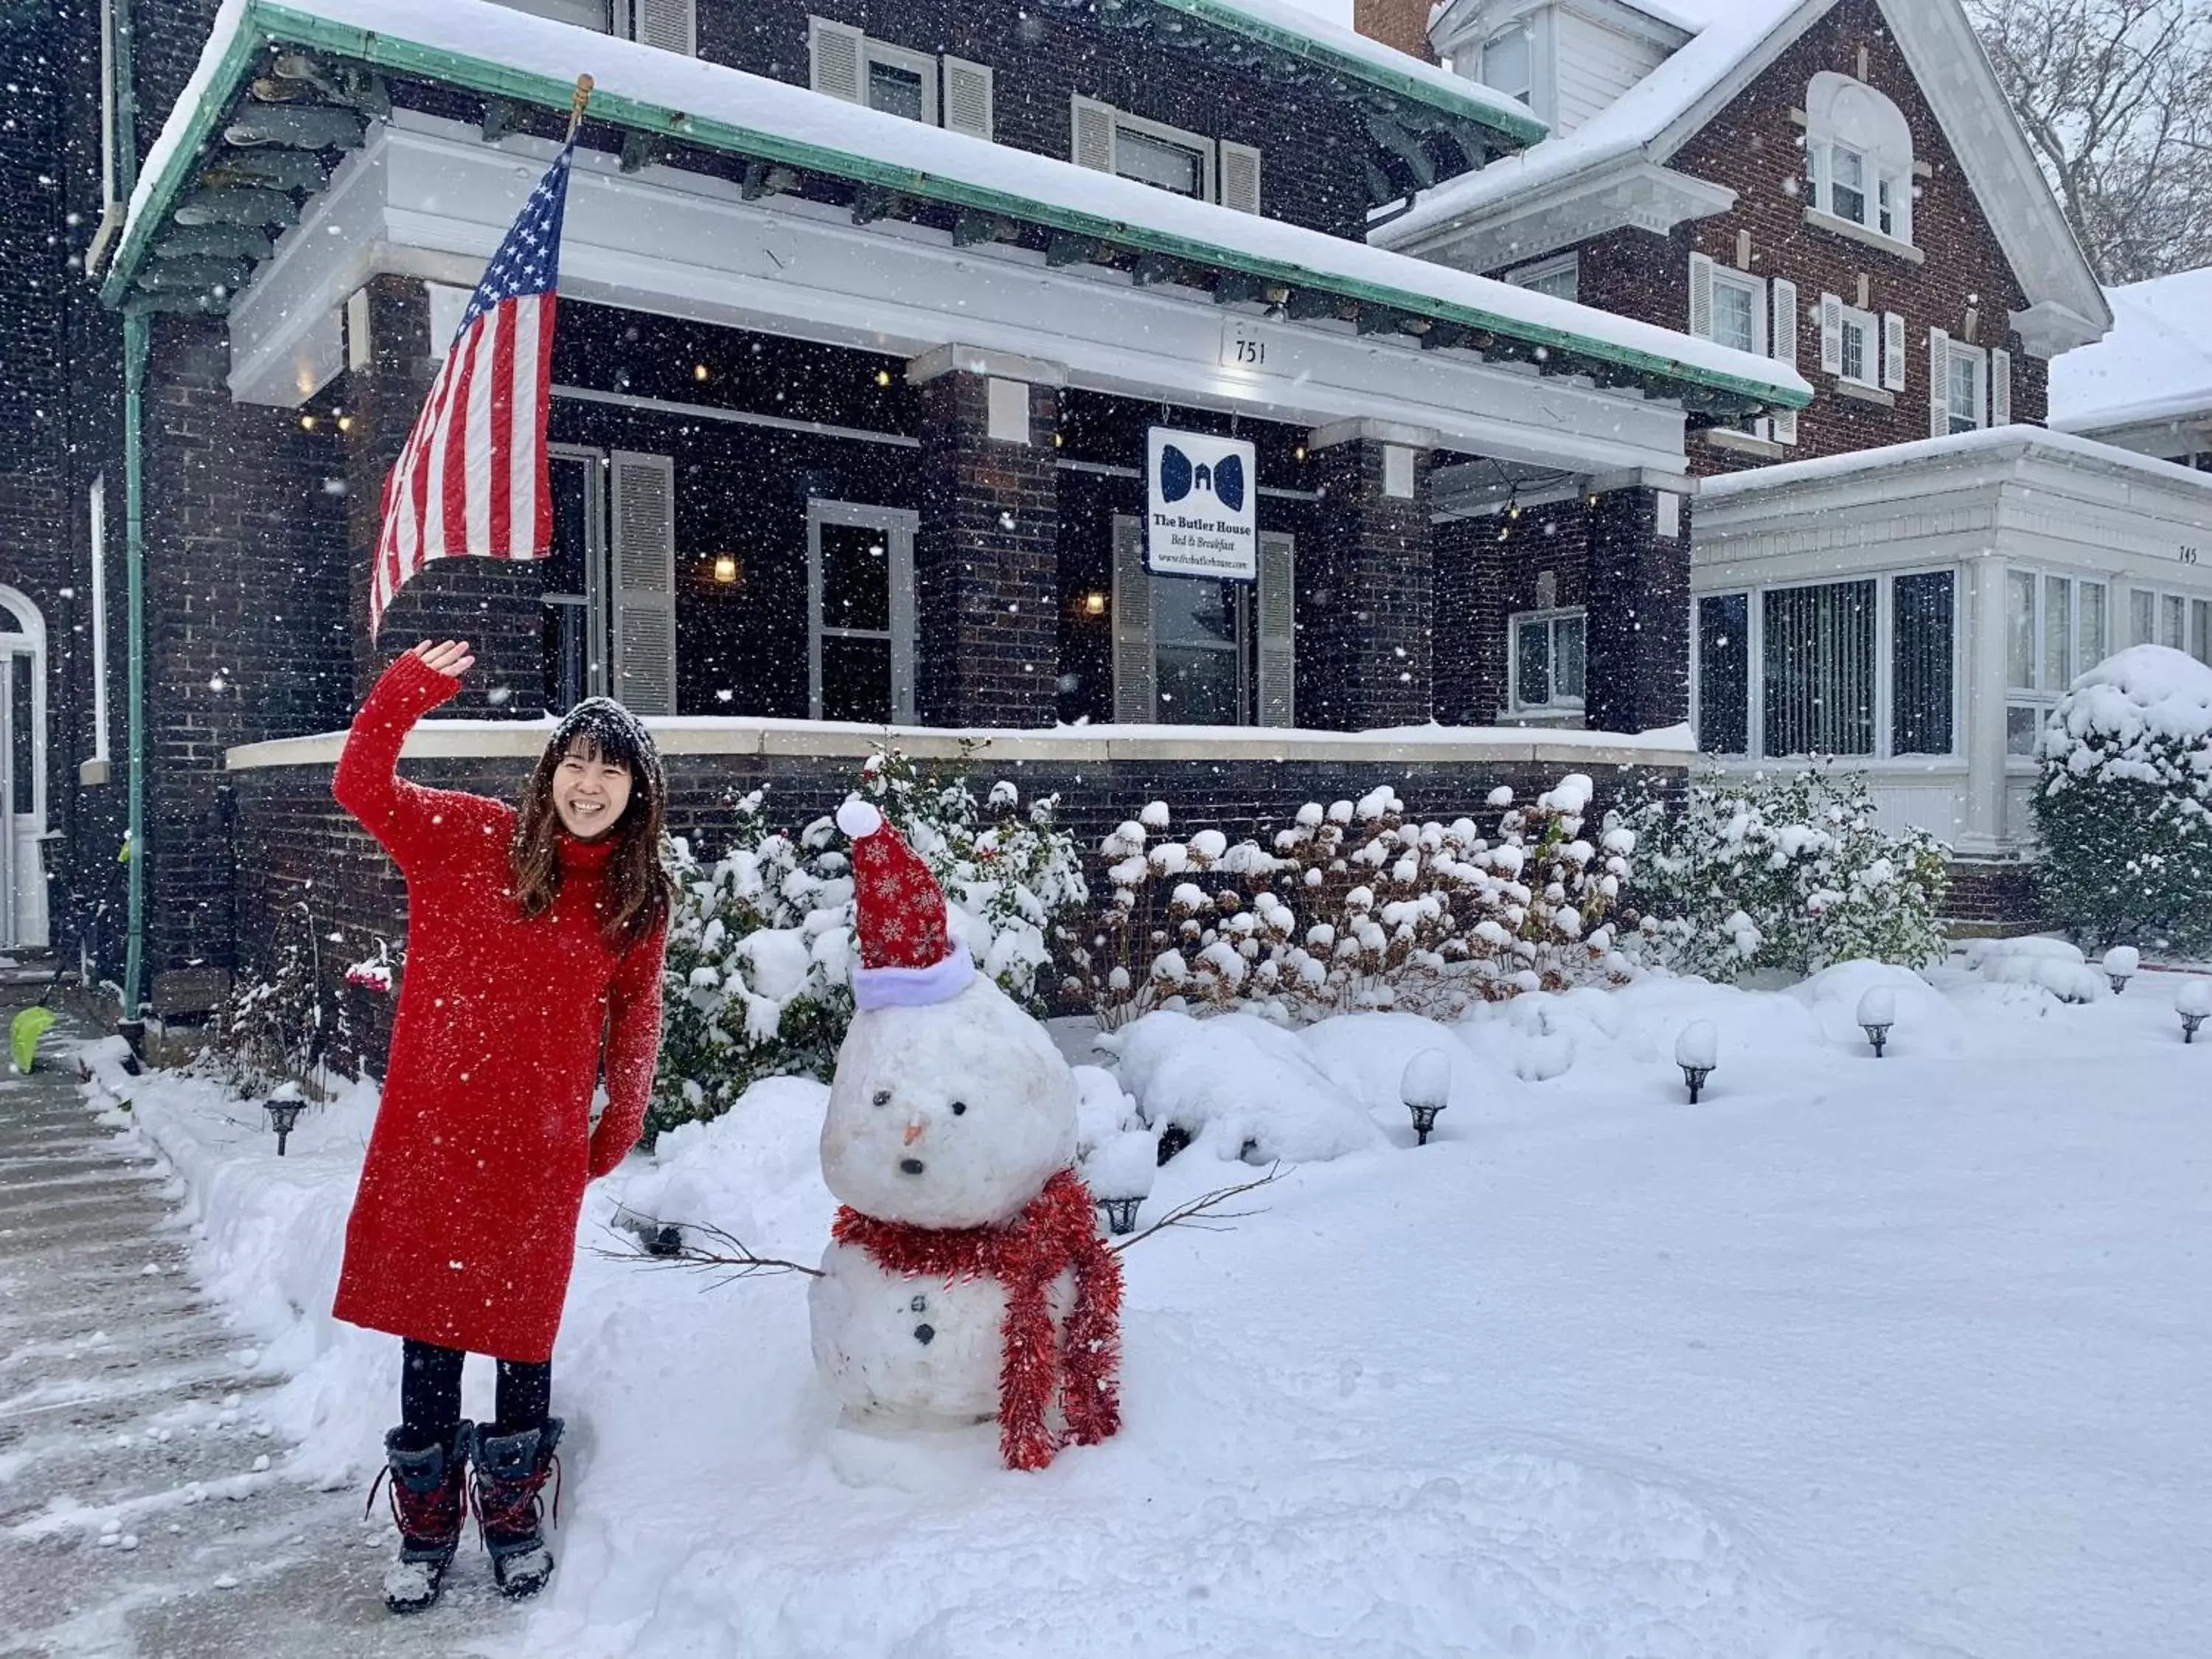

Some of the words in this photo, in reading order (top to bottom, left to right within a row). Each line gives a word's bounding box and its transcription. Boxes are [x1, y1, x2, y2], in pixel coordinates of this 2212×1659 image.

[1237, 340, 1265, 364] 751
[1153, 513, 1176, 527] The
[1178, 516, 1214, 532] Butler
[1217, 521, 1251, 536] House
[1171, 534, 1186, 546] Bed
[1188, 535, 1195, 546] &
[1197, 536, 1235, 552] Breakfast
[2180, 546, 2197, 565] 745
